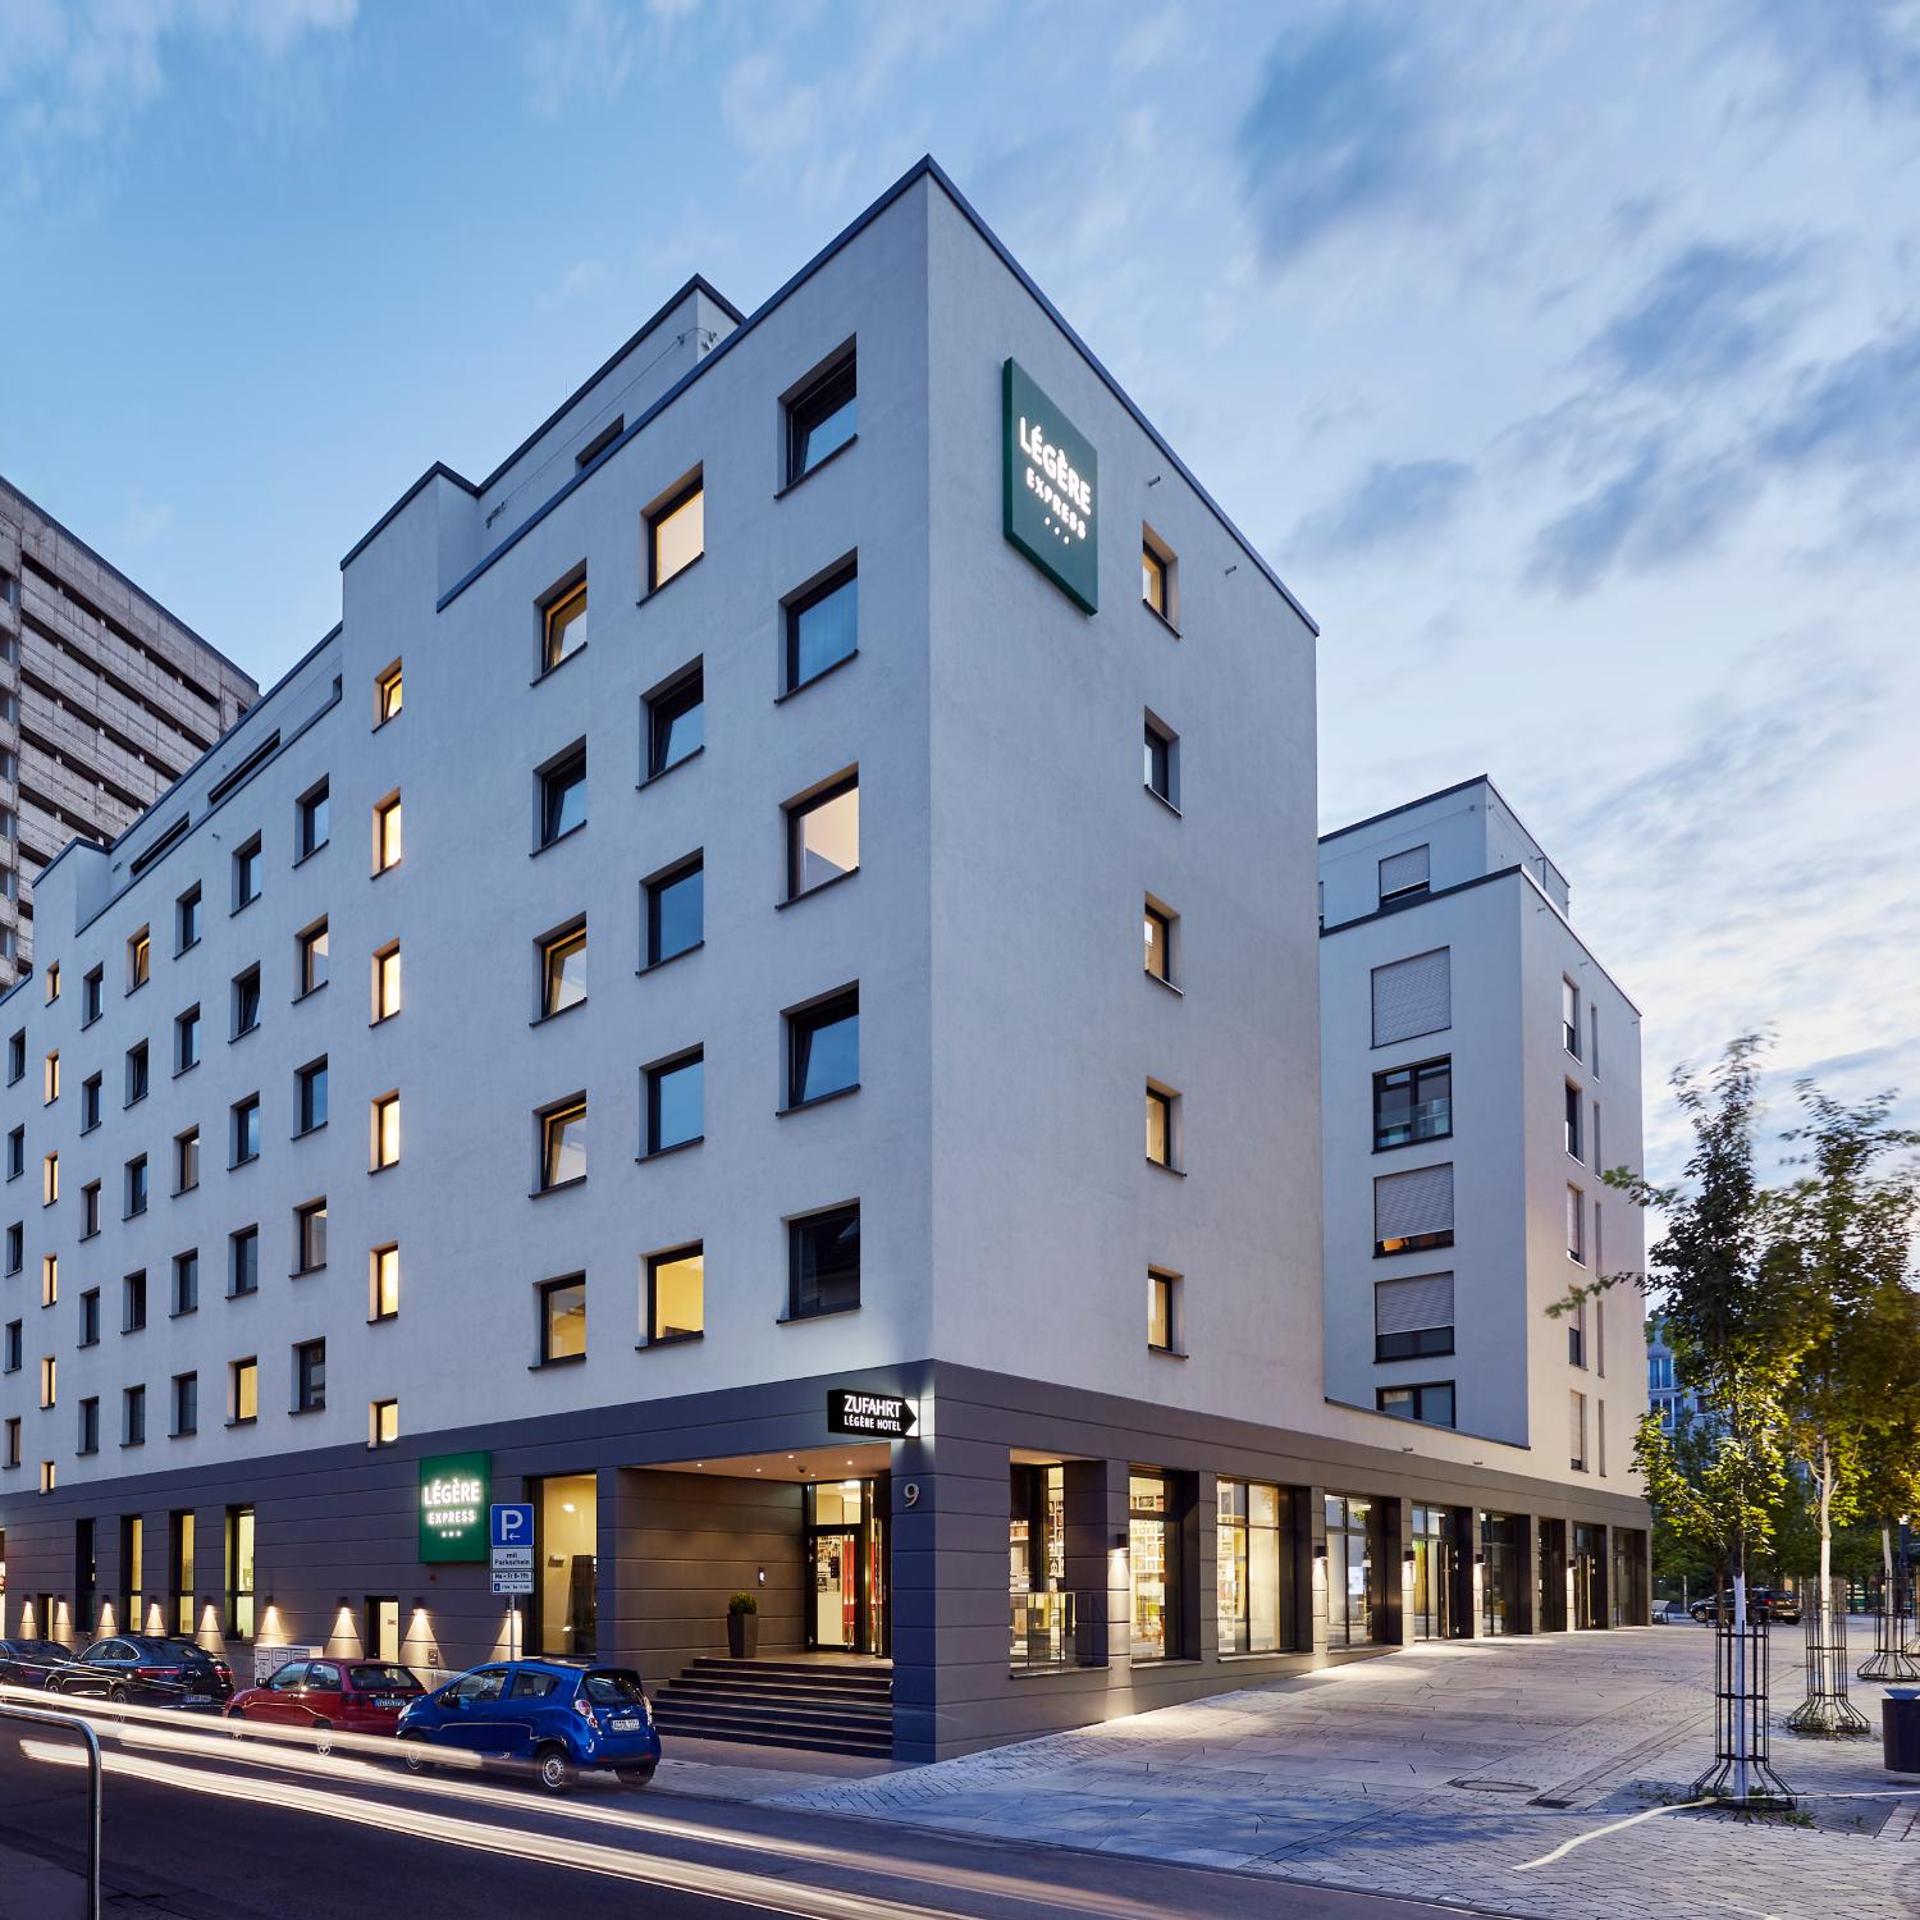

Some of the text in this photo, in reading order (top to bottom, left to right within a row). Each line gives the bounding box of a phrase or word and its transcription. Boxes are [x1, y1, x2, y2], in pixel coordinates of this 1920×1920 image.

[1020, 416, 1091, 516] LÉGÈRE
[1026, 466, 1087, 540] EXPRESS
[844, 1394, 902, 1418] ZUFAHRT
[844, 1414, 902, 1432] LÉGÈRE HOTEL
[423, 1478, 482, 1506] LÉGÈRE
[903, 1482, 920, 1508] 9
[428, 1510, 477, 1525] EXPRESS
[501, 1509, 524, 1541] P
